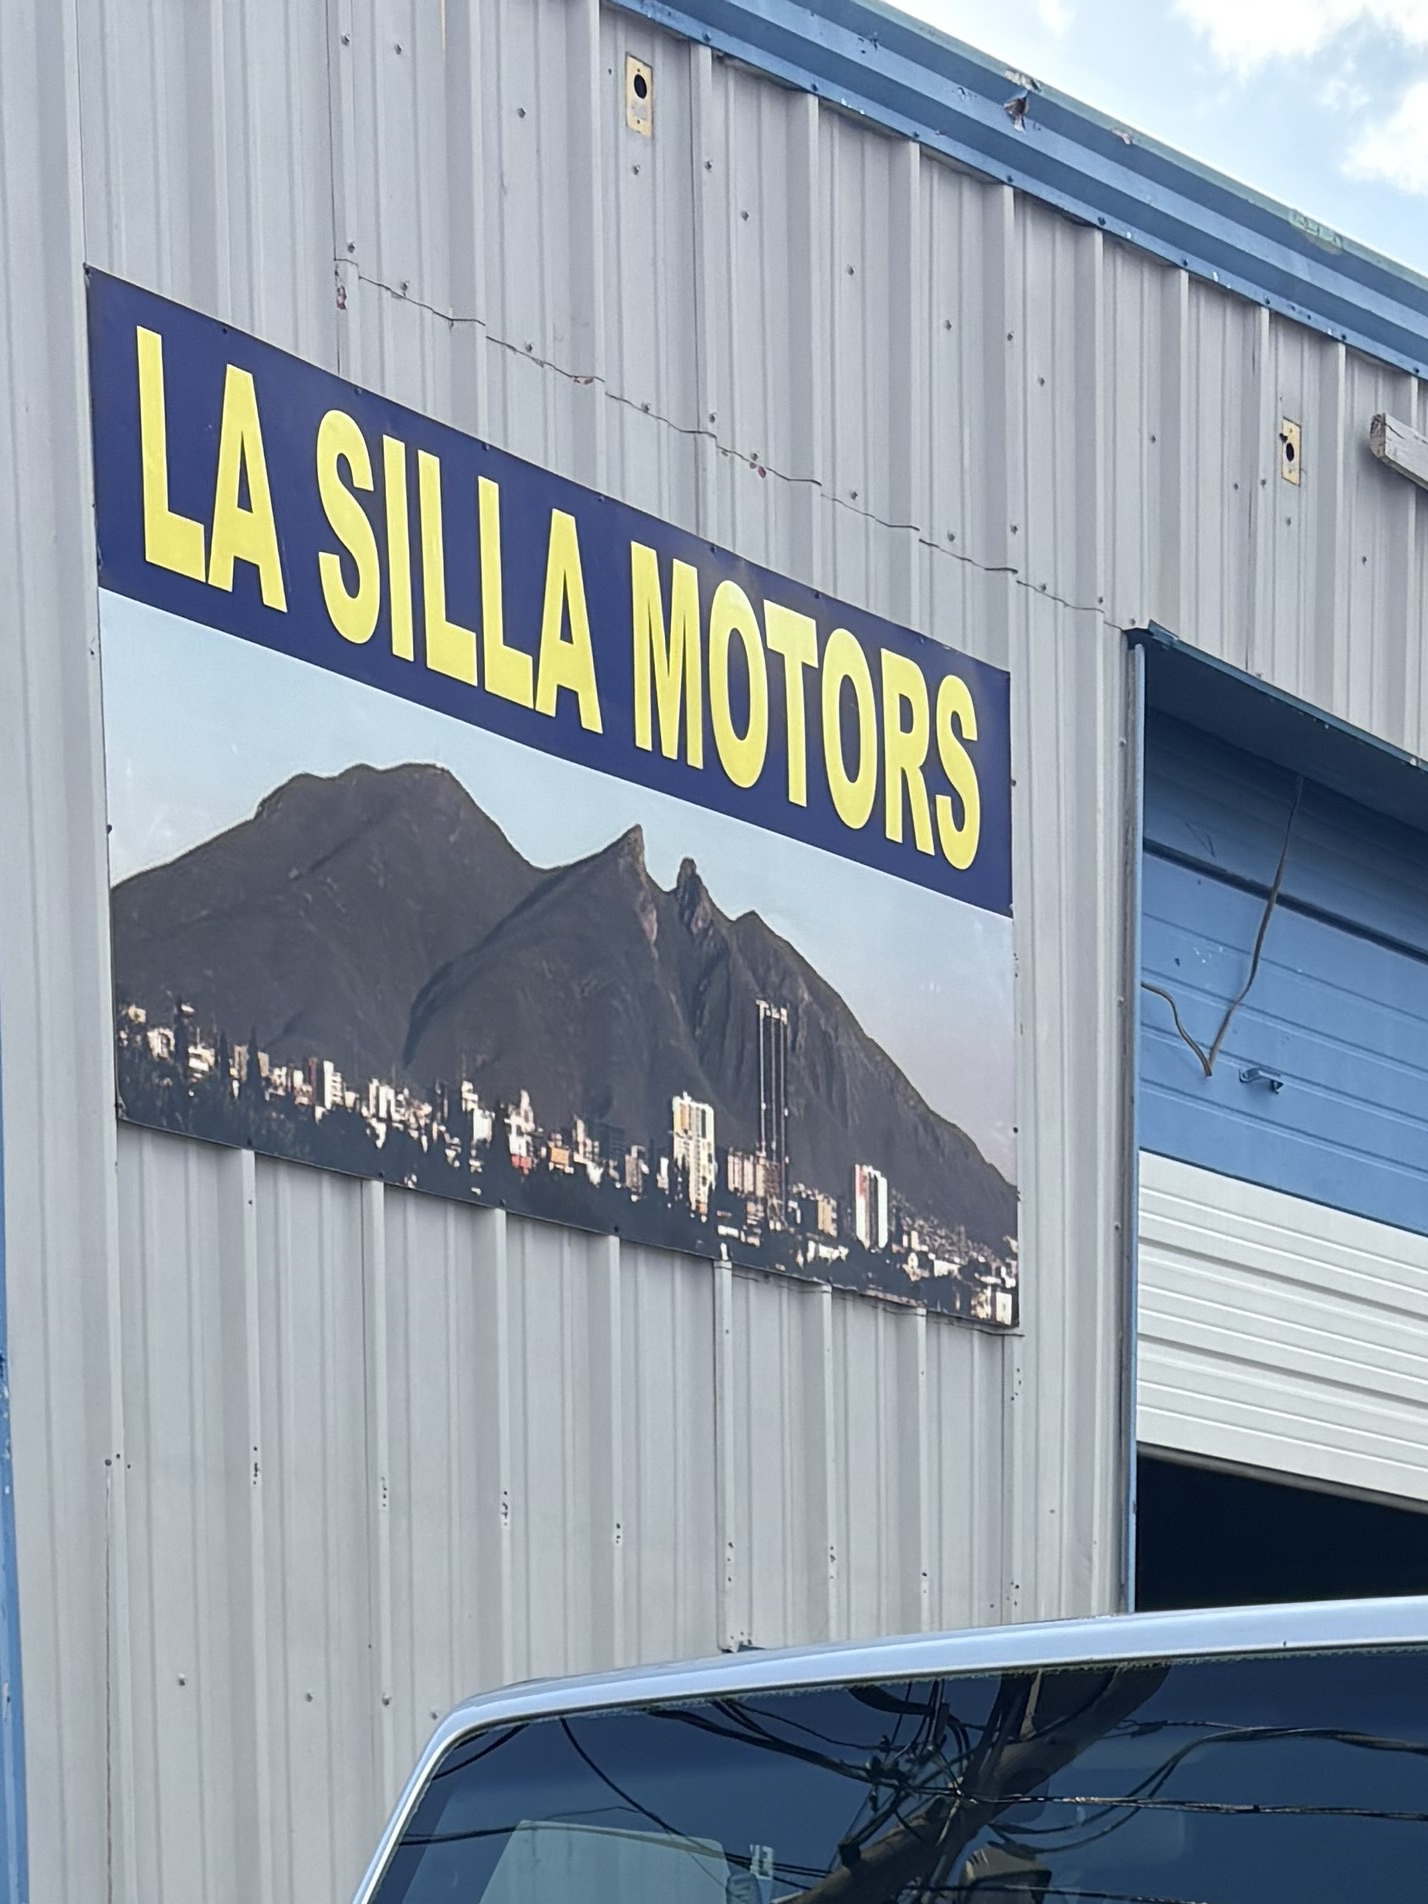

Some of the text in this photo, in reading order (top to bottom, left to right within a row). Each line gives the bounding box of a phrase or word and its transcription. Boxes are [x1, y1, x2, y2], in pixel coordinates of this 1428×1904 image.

[136, 325, 980, 871] LA SILLA MOTORS
